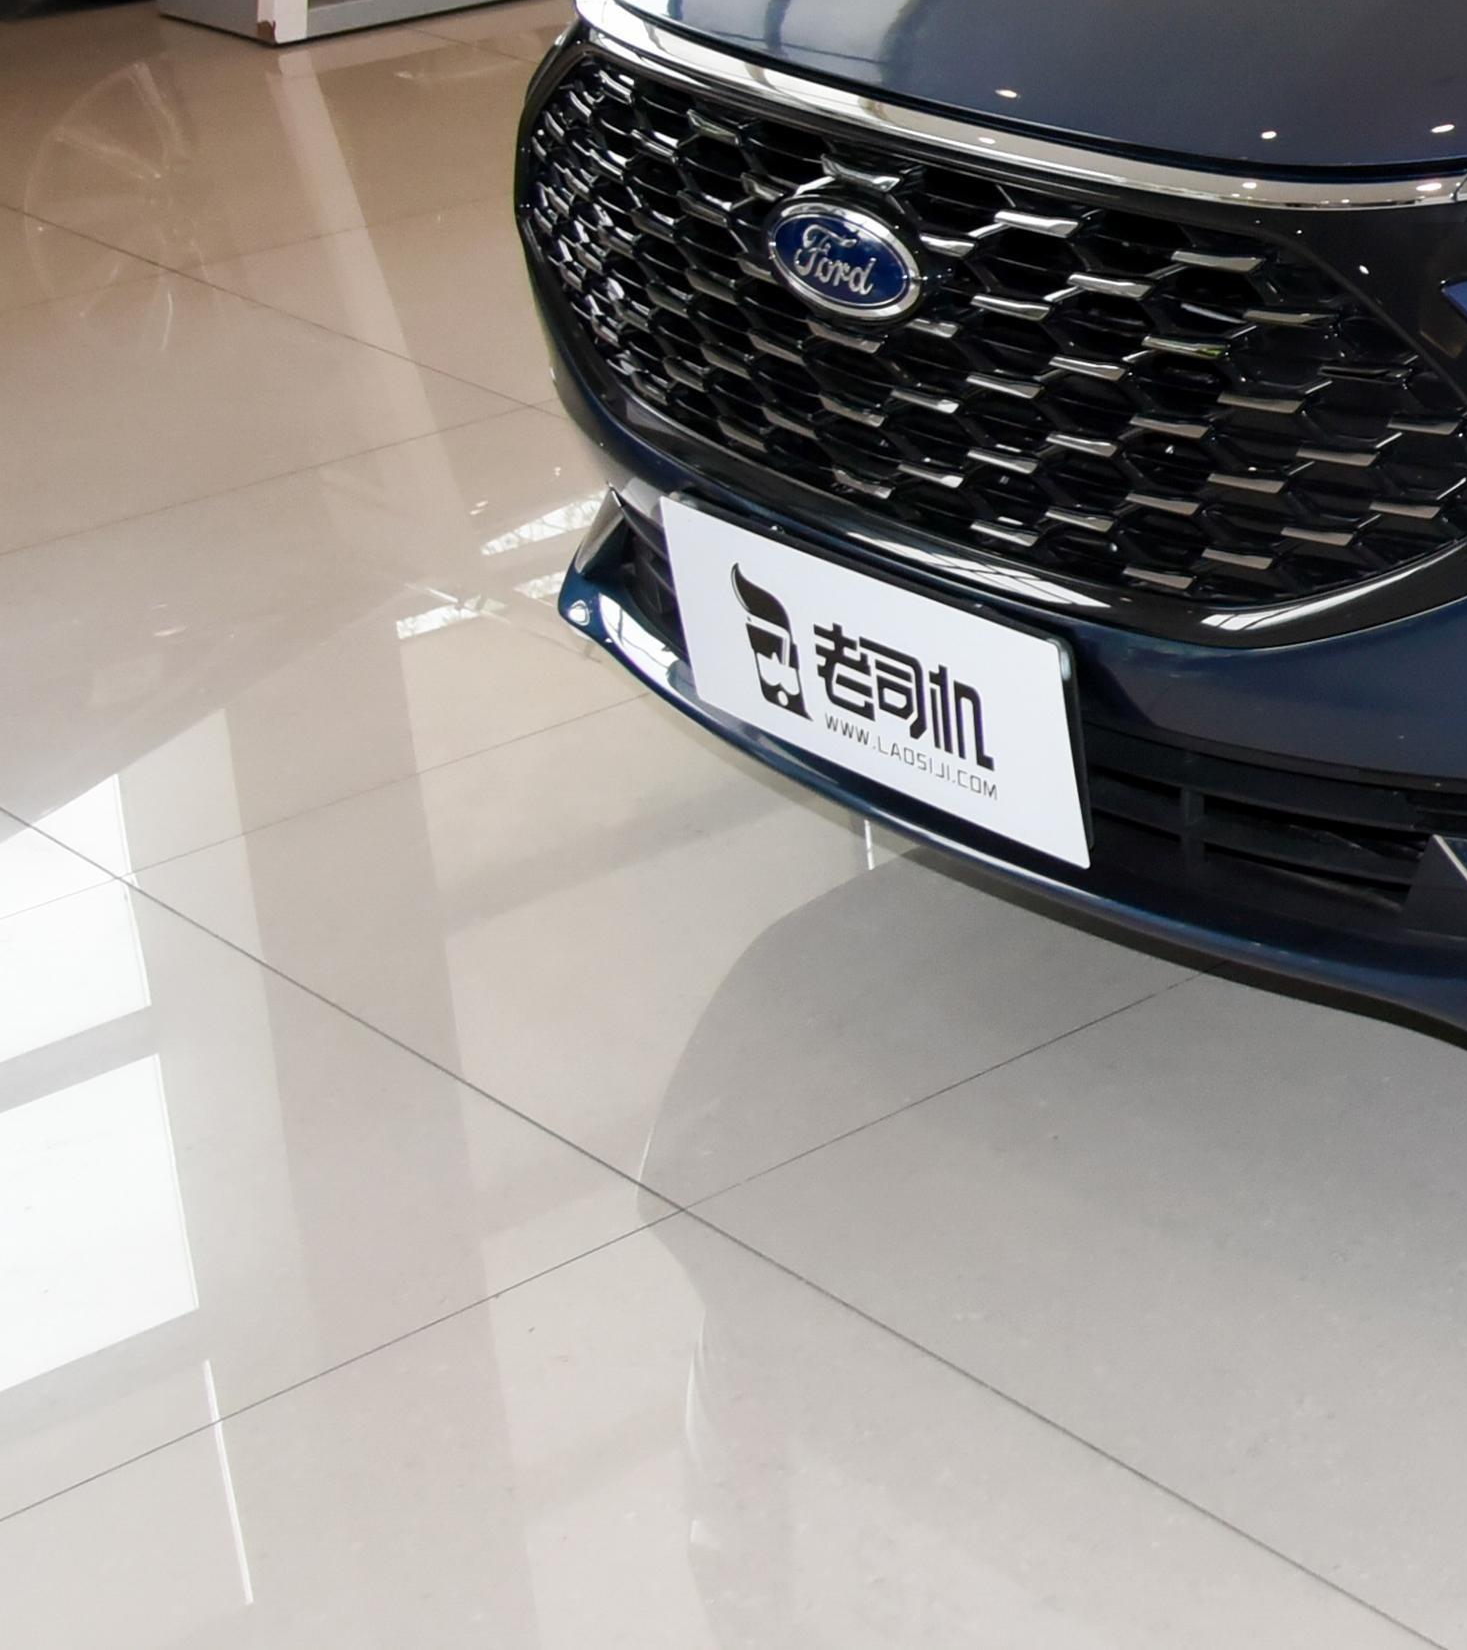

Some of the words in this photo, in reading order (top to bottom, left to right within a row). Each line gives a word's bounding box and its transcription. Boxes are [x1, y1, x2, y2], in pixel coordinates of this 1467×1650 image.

[794, 223, 877, 295] Ford
[812, 621, 996, 772] 老司机
[823, 711, 998, 801] WWW.LAOSIJI.COM
